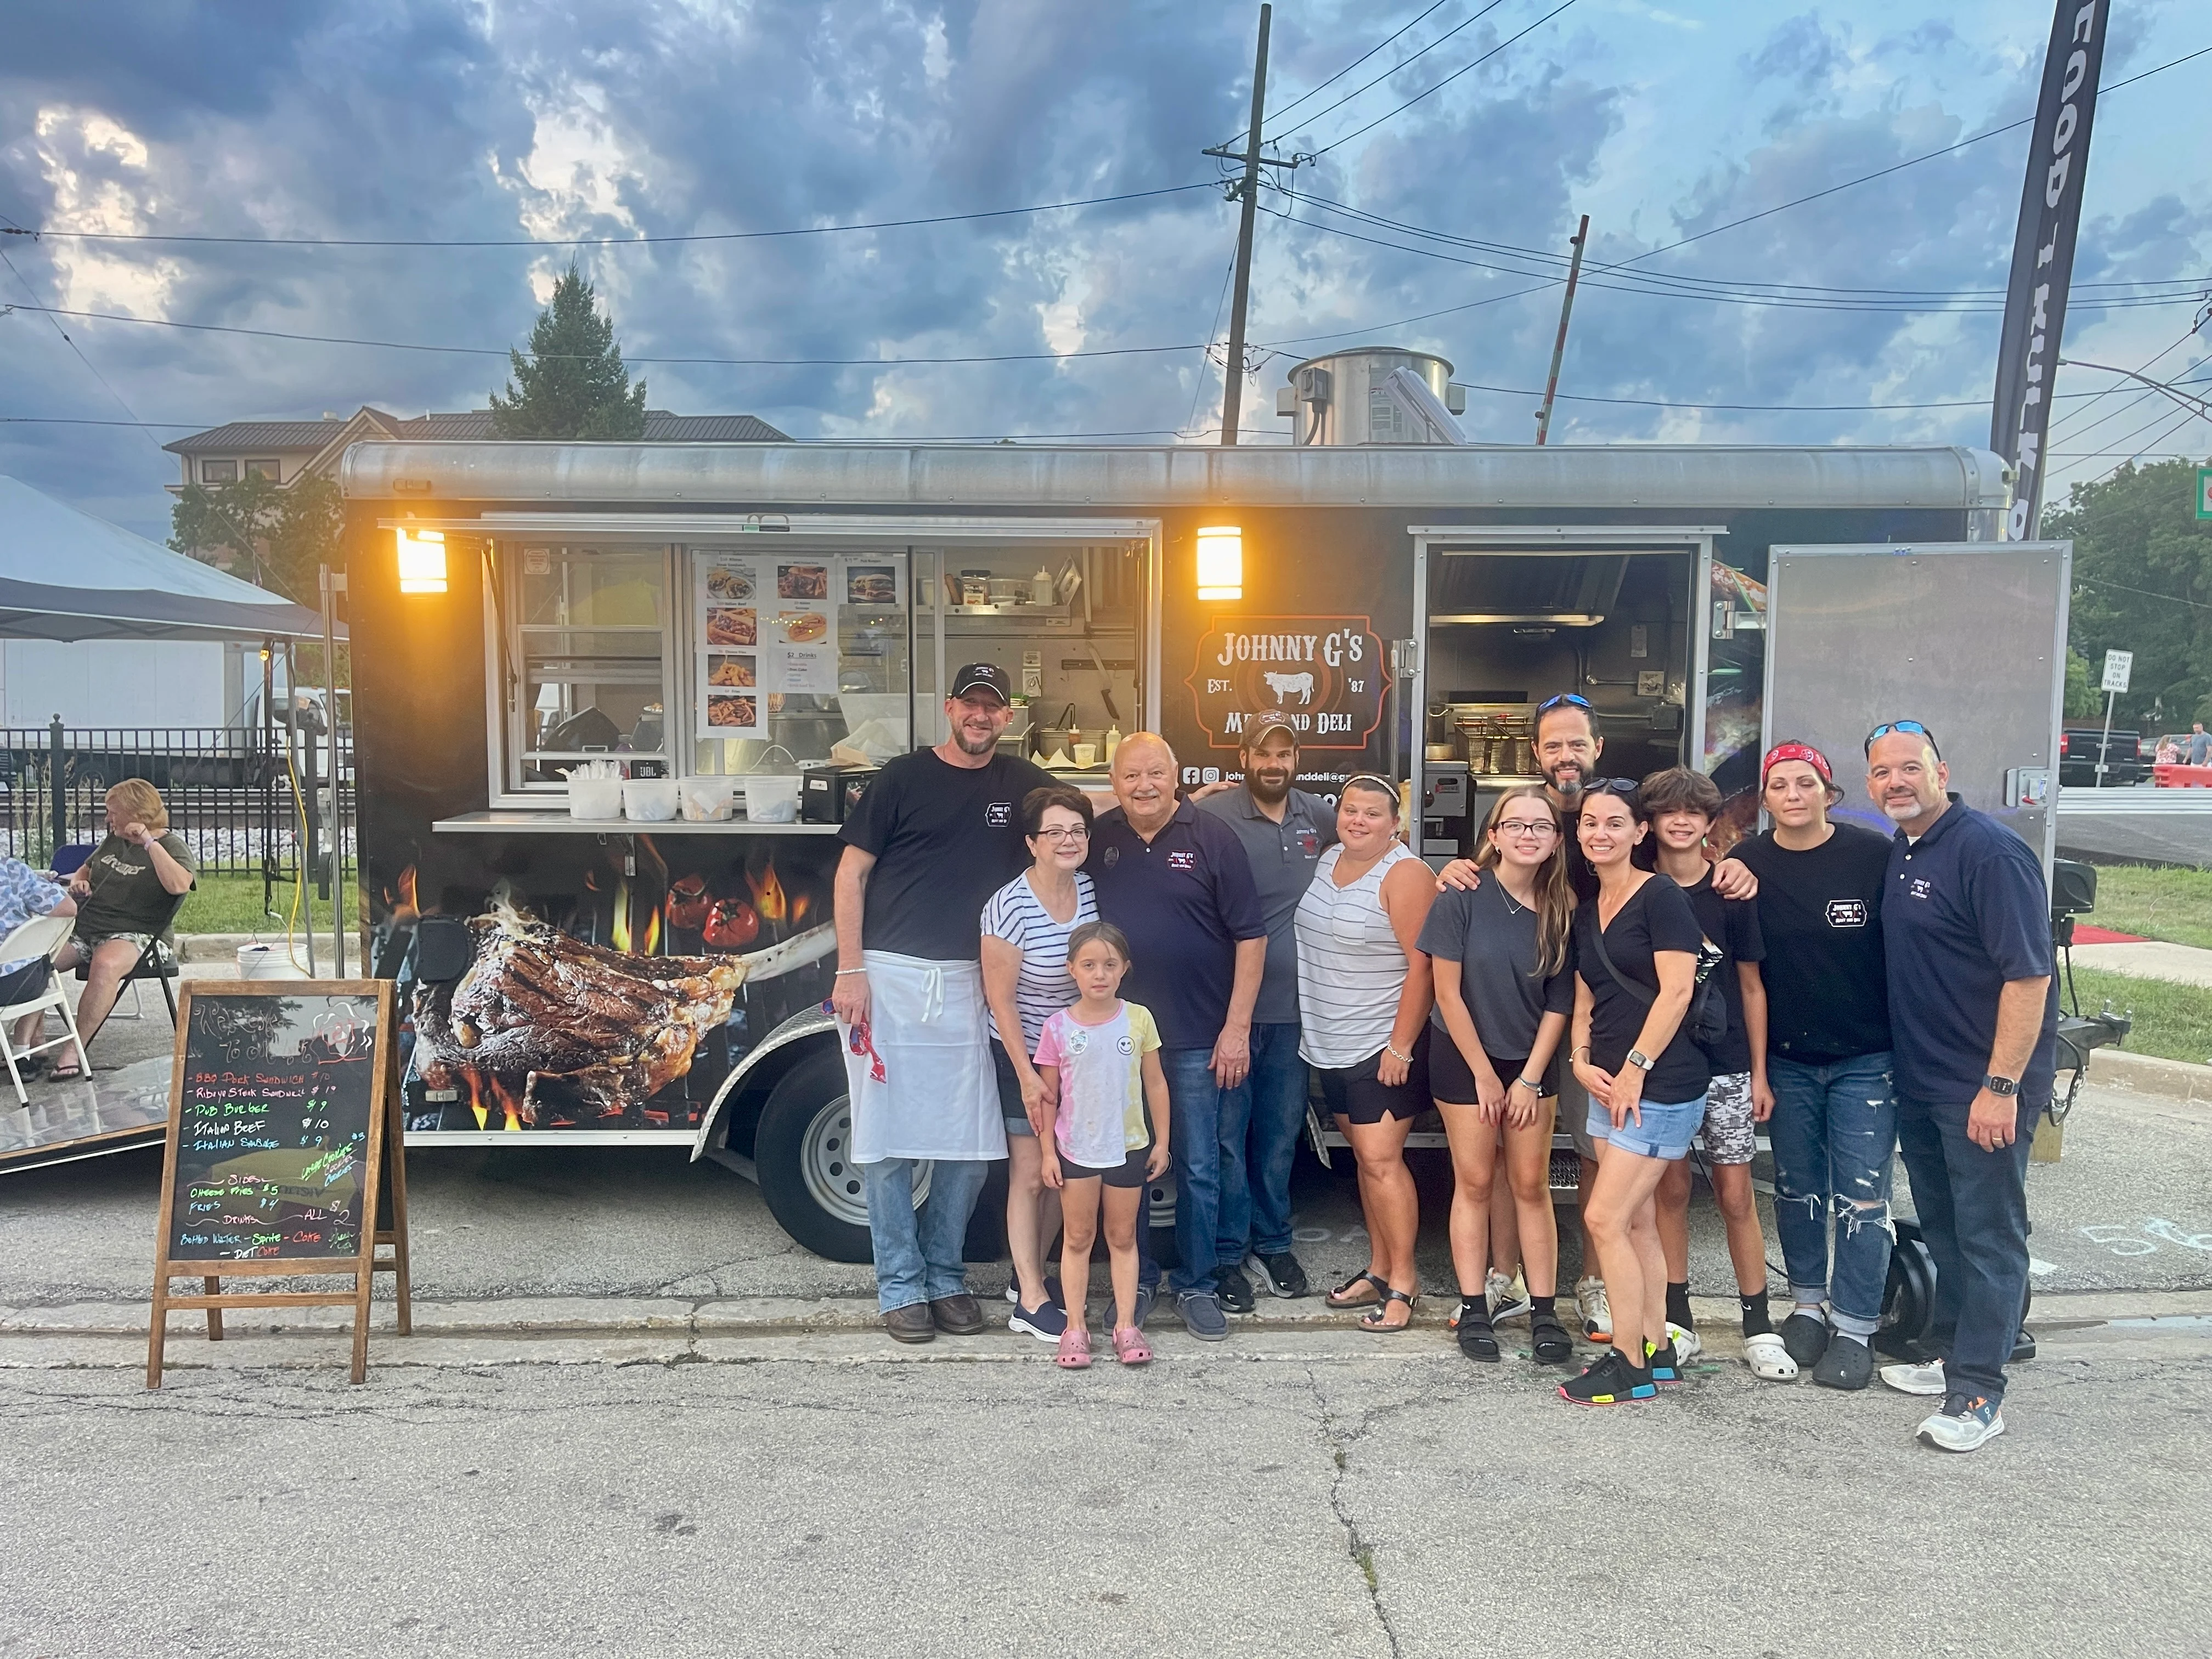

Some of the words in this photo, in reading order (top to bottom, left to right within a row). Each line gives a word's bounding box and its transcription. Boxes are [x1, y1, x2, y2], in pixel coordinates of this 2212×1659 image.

[1217, 632, 1318, 667] JOHNNY
[1323, 628, 1363, 667] G'S
[2118, 654, 2130, 663] NOT
[2110, 663, 2126, 671] STOP
[1207, 679, 1233, 693] EST.
[1348, 678, 1365, 692] '87
[2104, 679, 2127, 688] TRACKS
[1290, 713, 1311, 731] ND
[1317, 712, 1352, 734] DELI
[640, 766, 657, 777] JBL
[195, 1072, 217, 1084] BBQ
[189, 1200, 221, 1215] FRIES
[304, 1209, 328, 1221] ALL
